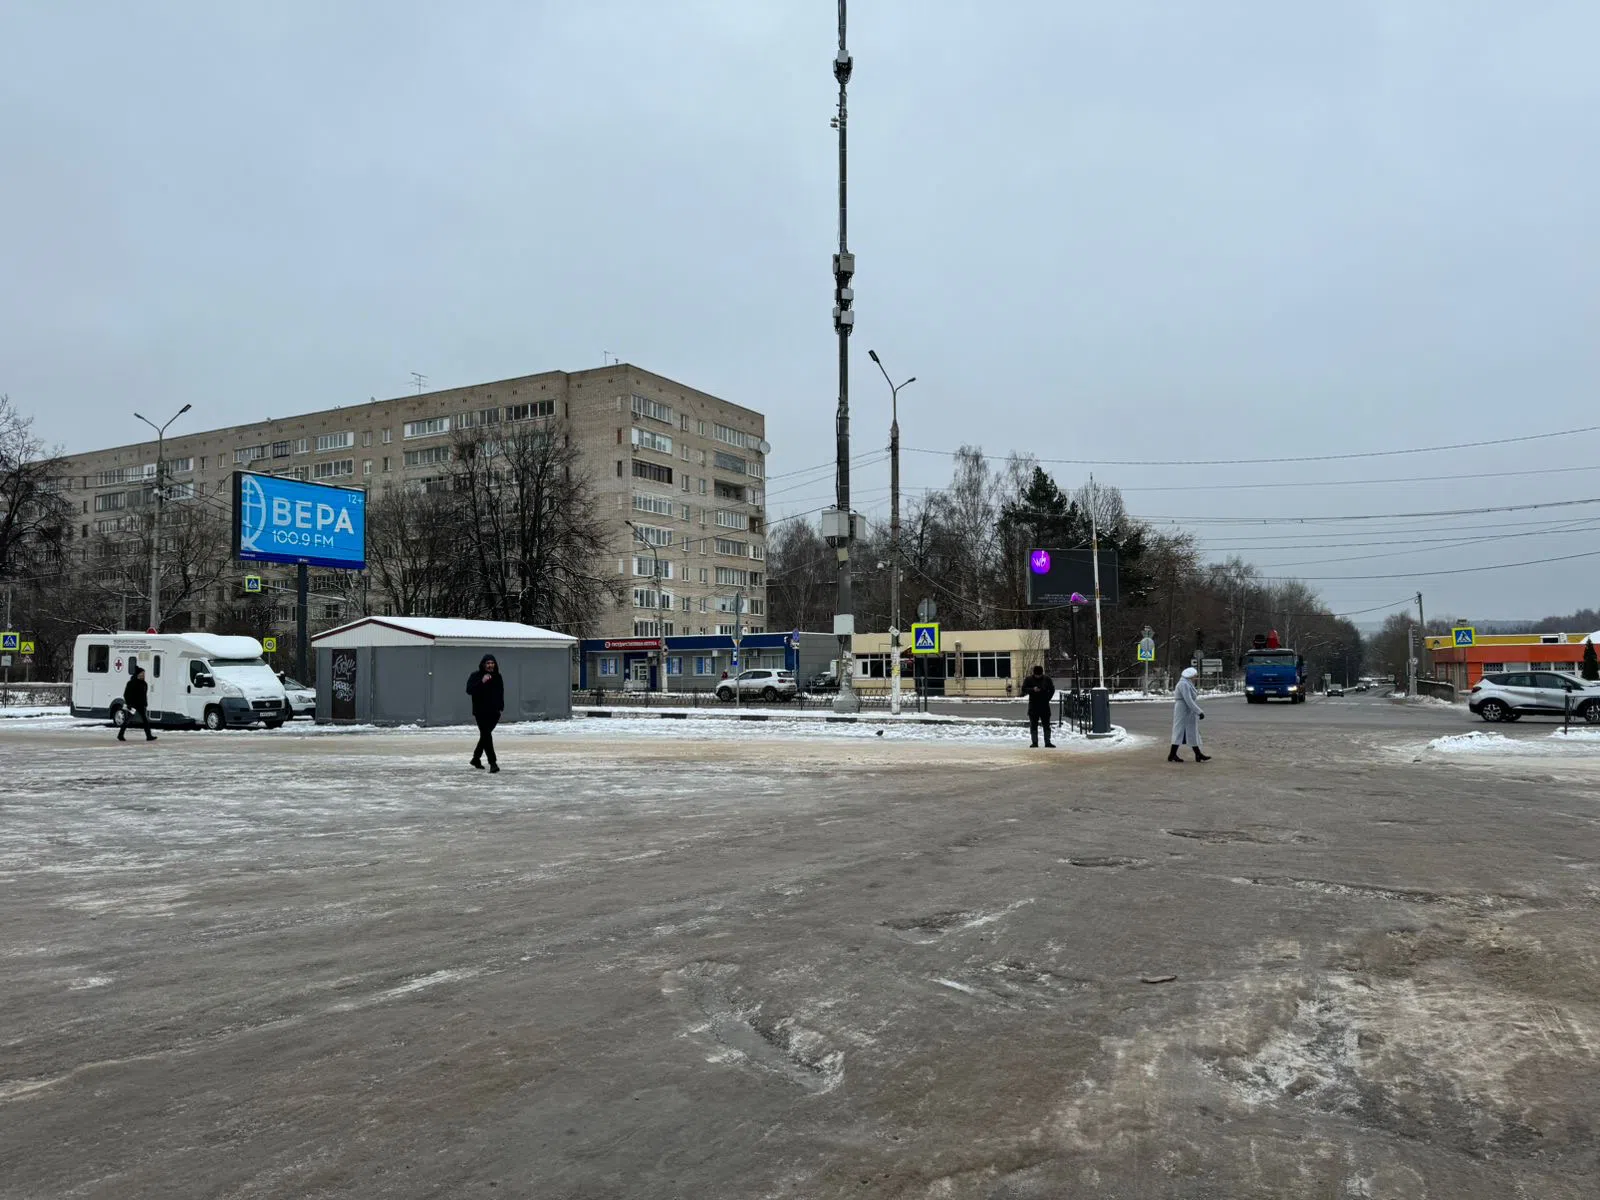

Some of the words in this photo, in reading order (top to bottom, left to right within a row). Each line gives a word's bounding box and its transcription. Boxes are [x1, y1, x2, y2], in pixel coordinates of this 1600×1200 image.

[348, 494, 363, 504] 12+
[272, 497, 354, 534] ВЕРА
[272, 530, 310, 546] 100.9
[315, 534, 334, 548] FM
